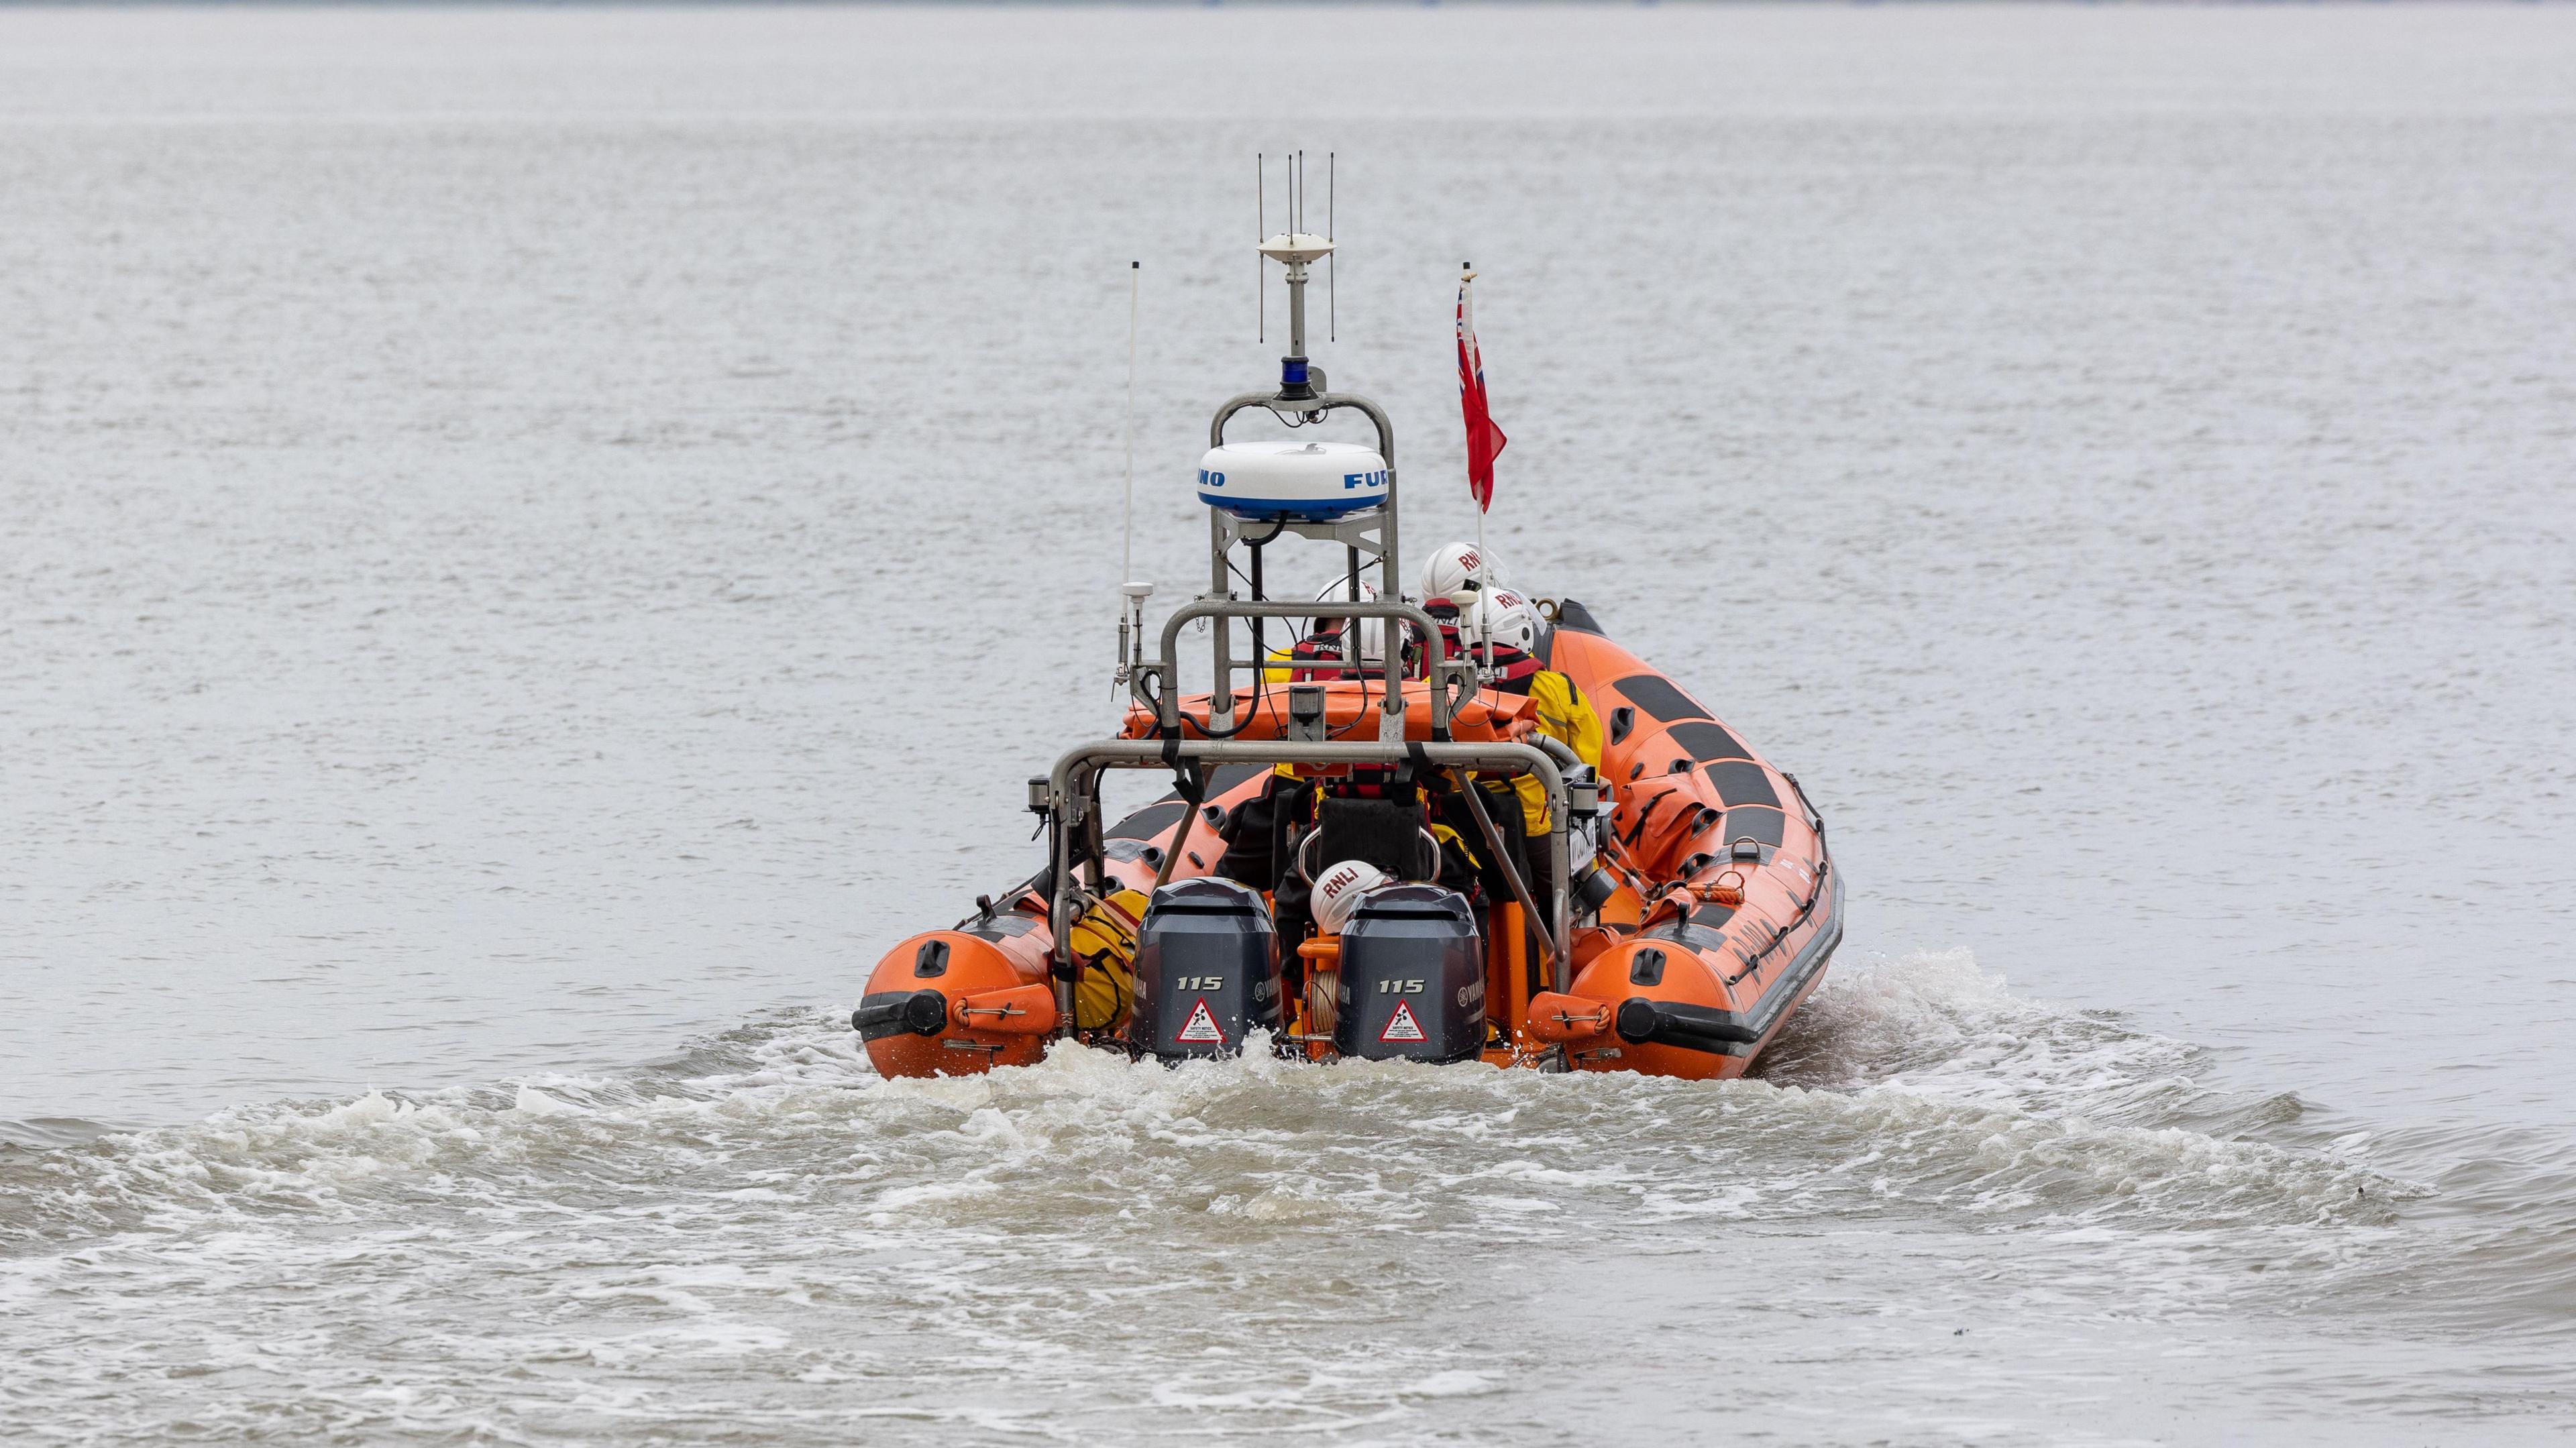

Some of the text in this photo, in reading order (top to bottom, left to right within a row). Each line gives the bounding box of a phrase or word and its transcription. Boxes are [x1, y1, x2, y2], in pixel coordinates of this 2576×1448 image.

[1197, 468, 1225, 487] NO
[1458, 550, 1481, 572] RN
[1495, 592, 1523, 609] RNL
[1435, 618, 1458, 626] NLI
[1322, 867, 1359, 899] RNLI
[1177, 977, 1224, 991] 115
[1379, 979, 1426, 994] 115
